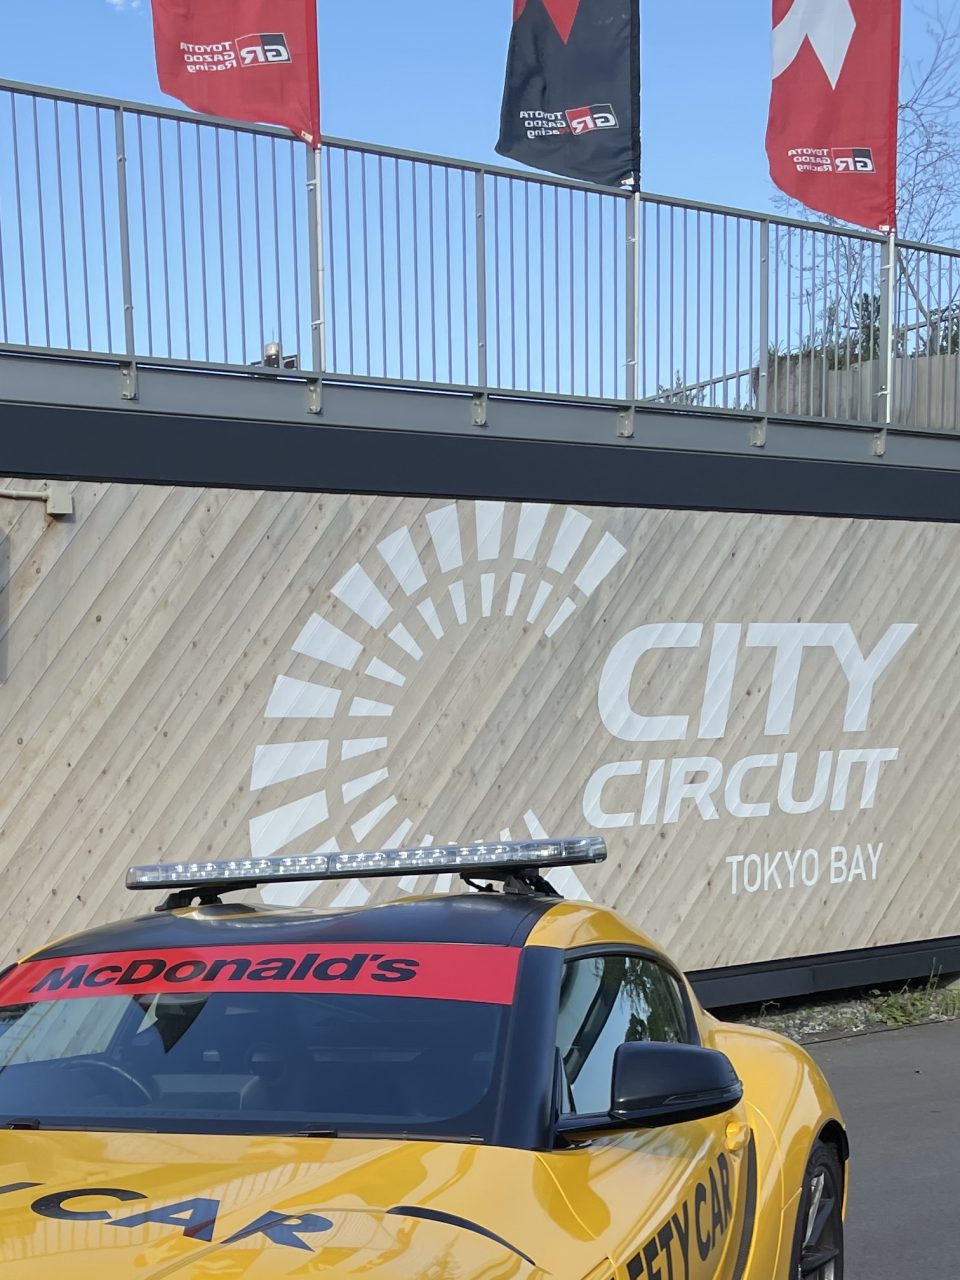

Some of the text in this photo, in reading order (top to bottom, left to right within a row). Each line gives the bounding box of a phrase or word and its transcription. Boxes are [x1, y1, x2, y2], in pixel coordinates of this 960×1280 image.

[597, 622, 919, 742] CITY
[582, 748, 899, 829] CIRCUIT
[726, 842, 884, 895] TOKYO BAY
[28, 953, 421, 993] McDonald's
[31, 1188, 334, 1252] CAR
[694, 1151, 734, 1262] CAR
